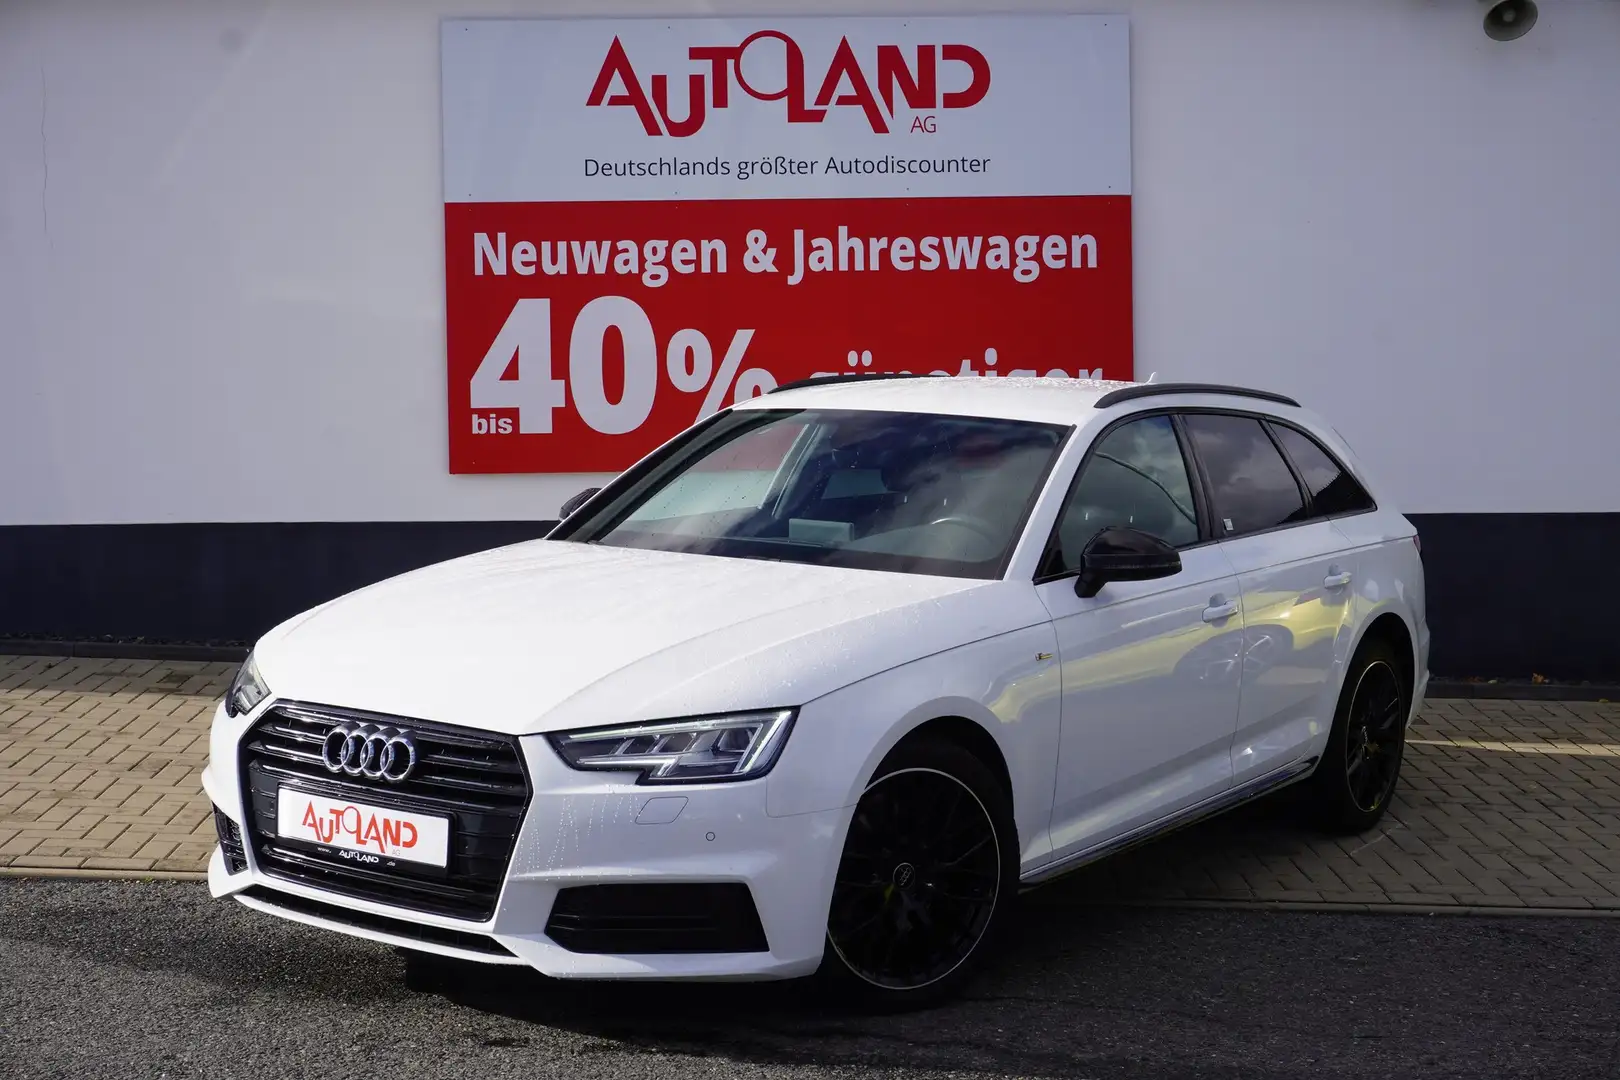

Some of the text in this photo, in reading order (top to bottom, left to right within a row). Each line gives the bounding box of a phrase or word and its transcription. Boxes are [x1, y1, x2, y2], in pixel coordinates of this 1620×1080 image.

[910, 115, 937, 134] AG
[583, 155, 991, 180] Deutschlands größter Autodiscounter
[473, 226, 1099, 287] Neuwagen & Jahreswagen
[471, 413, 513, 435] bis
